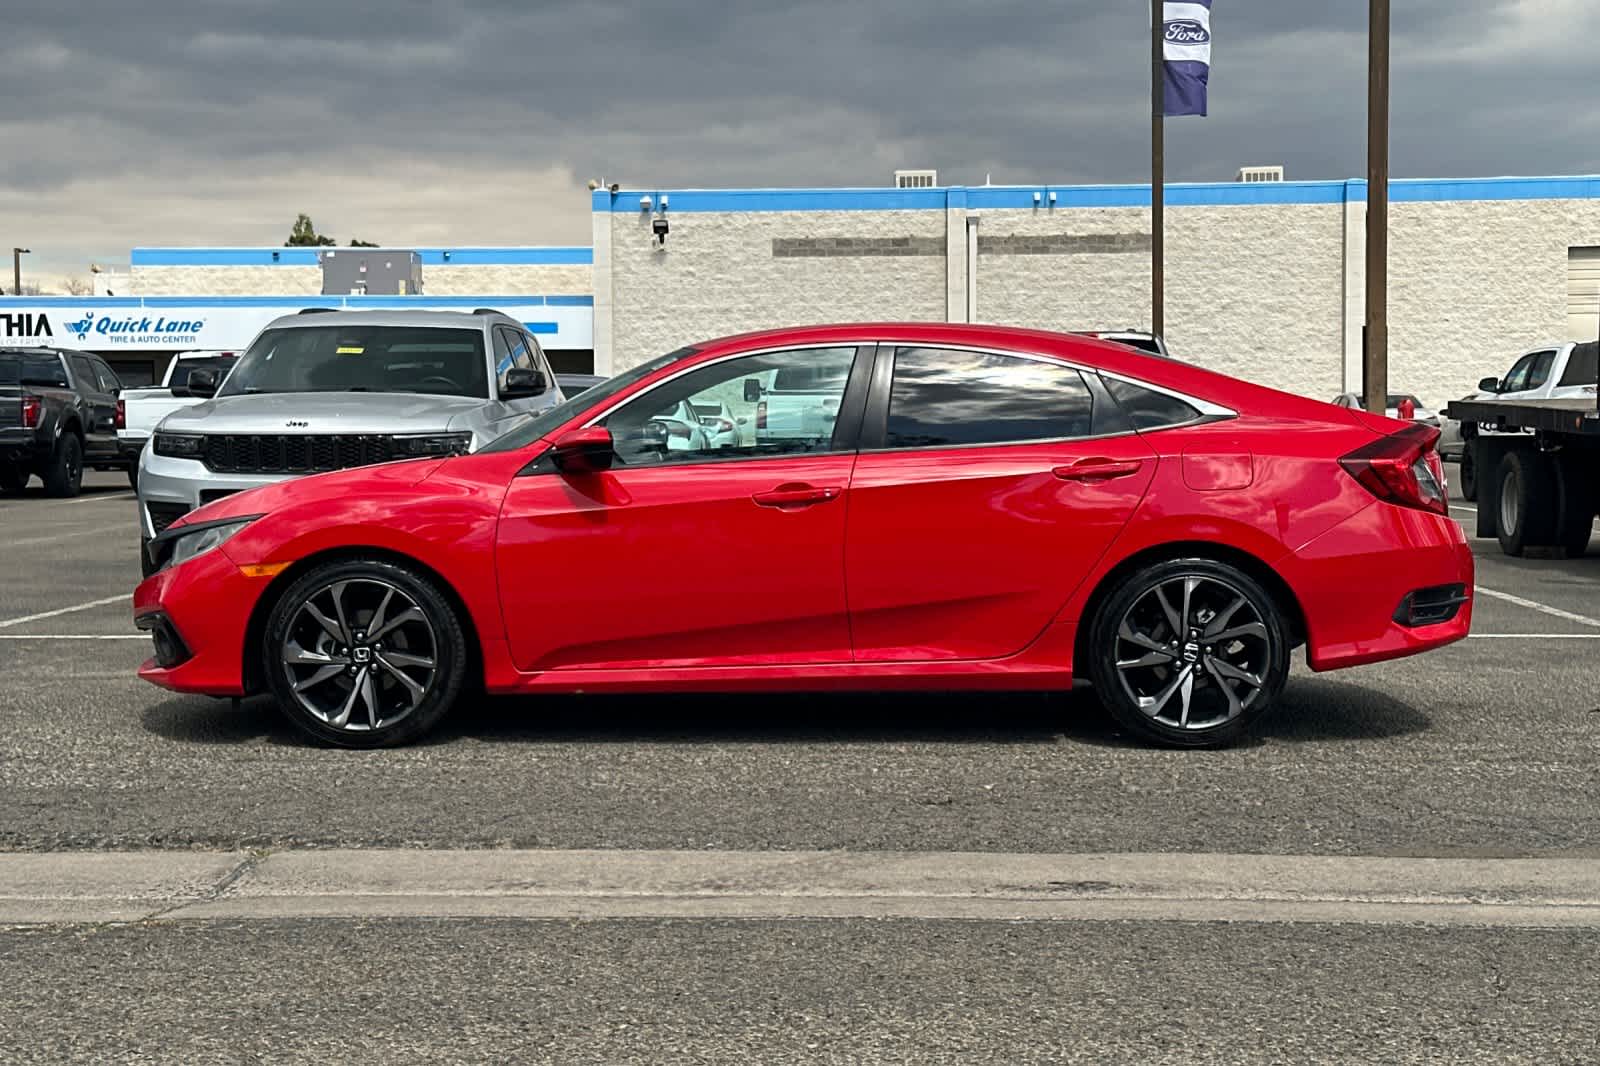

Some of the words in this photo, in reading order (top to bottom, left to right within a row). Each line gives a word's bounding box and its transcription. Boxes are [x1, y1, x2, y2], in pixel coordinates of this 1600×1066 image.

[1165, 23, 1205, 41] Ford
[96, 316, 152, 335] Quick
[154, 316, 203, 333] Lane
[109, 335, 129, 344] TIRE
[129, 335, 137, 344] &
[137, 335, 161, 344] AUTO
[162, 335, 196, 344] CENTER
[285, 420, 309, 428] Jeep
